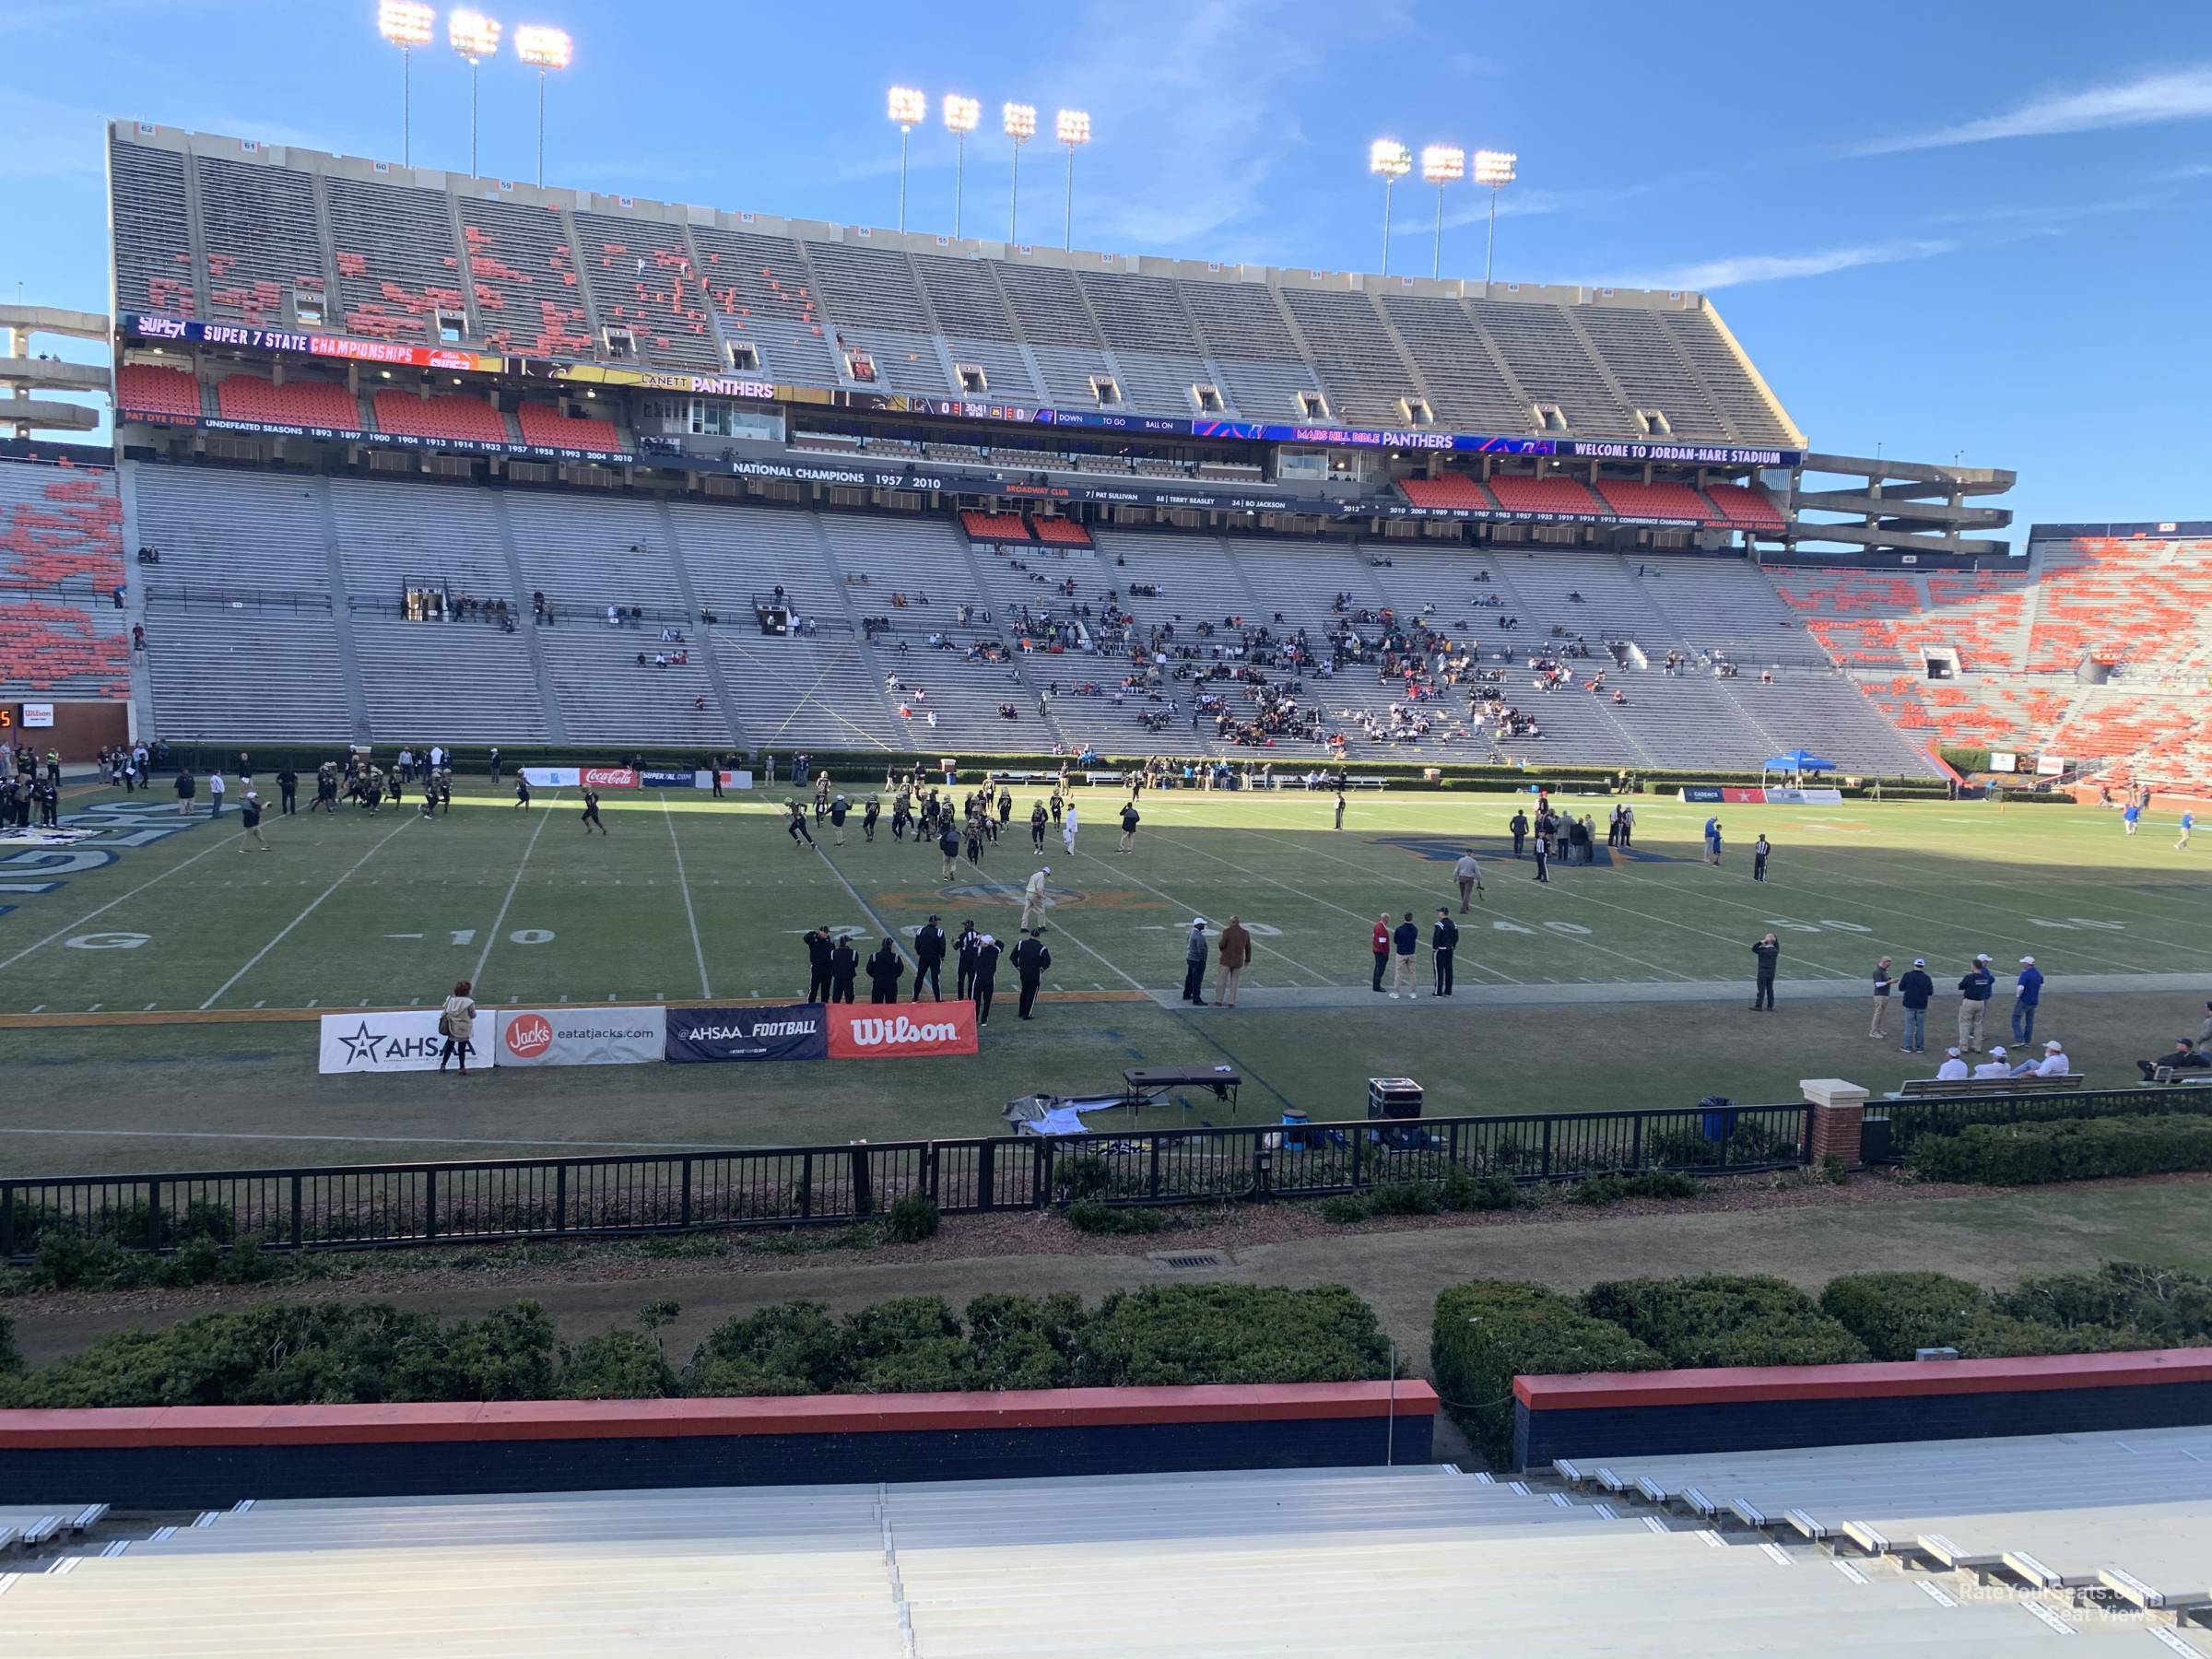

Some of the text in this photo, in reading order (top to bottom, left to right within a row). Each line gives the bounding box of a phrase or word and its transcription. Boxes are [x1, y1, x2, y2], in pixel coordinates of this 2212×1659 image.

[204, 325, 413, 362] SUPER 7 STATE CHAMPIONSHIPS
[641, 375, 774, 399] LANETT PANTHERS
[941, 402, 950, 414] 0
[1016, 408, 1025, 420] 0
[125, 411, 196, 426] PAT DYE FIELD
[1059, 414, 1083, 423] DOWN
[1146, 420, 1173, 429] BALL ON
[206, 419, 633, 463] UNDEFEATED SEASONS 1893 1897 1900 1904 1913 1914 1932 1957 1958 1993 2004 2010
[1382, 432, 1453, 449] PANTHERS
[1575, 443, 1781, 464] WELCOME TO JORDAN-HARE STADIUM
[733, 463, 941, 488] NATIONAL CHAMPIONS 1957 2010
[1006, 485, 1069, 496] BROADWAY CLUB
[1108, 492, 1138, 500] SULLIVAN
[1170, 496, 1188, 504] TERRY
[1255, 500, 1286, 509] JACKSON
[1659, 518, 1697, 526] CHAMPIONS
[1755, 522, 1786, 530] STADIUM
[2018, 756, 2036, 771] 25
[586, 768, 633, 784] Coca-Cola
[65, 932, 152, 949] G
[510, 1020, 550, 1049] Jack's
[558, 1028, 654, 1041] eatatjacks.com
[851, 1016, 957, 1046] Wilson
